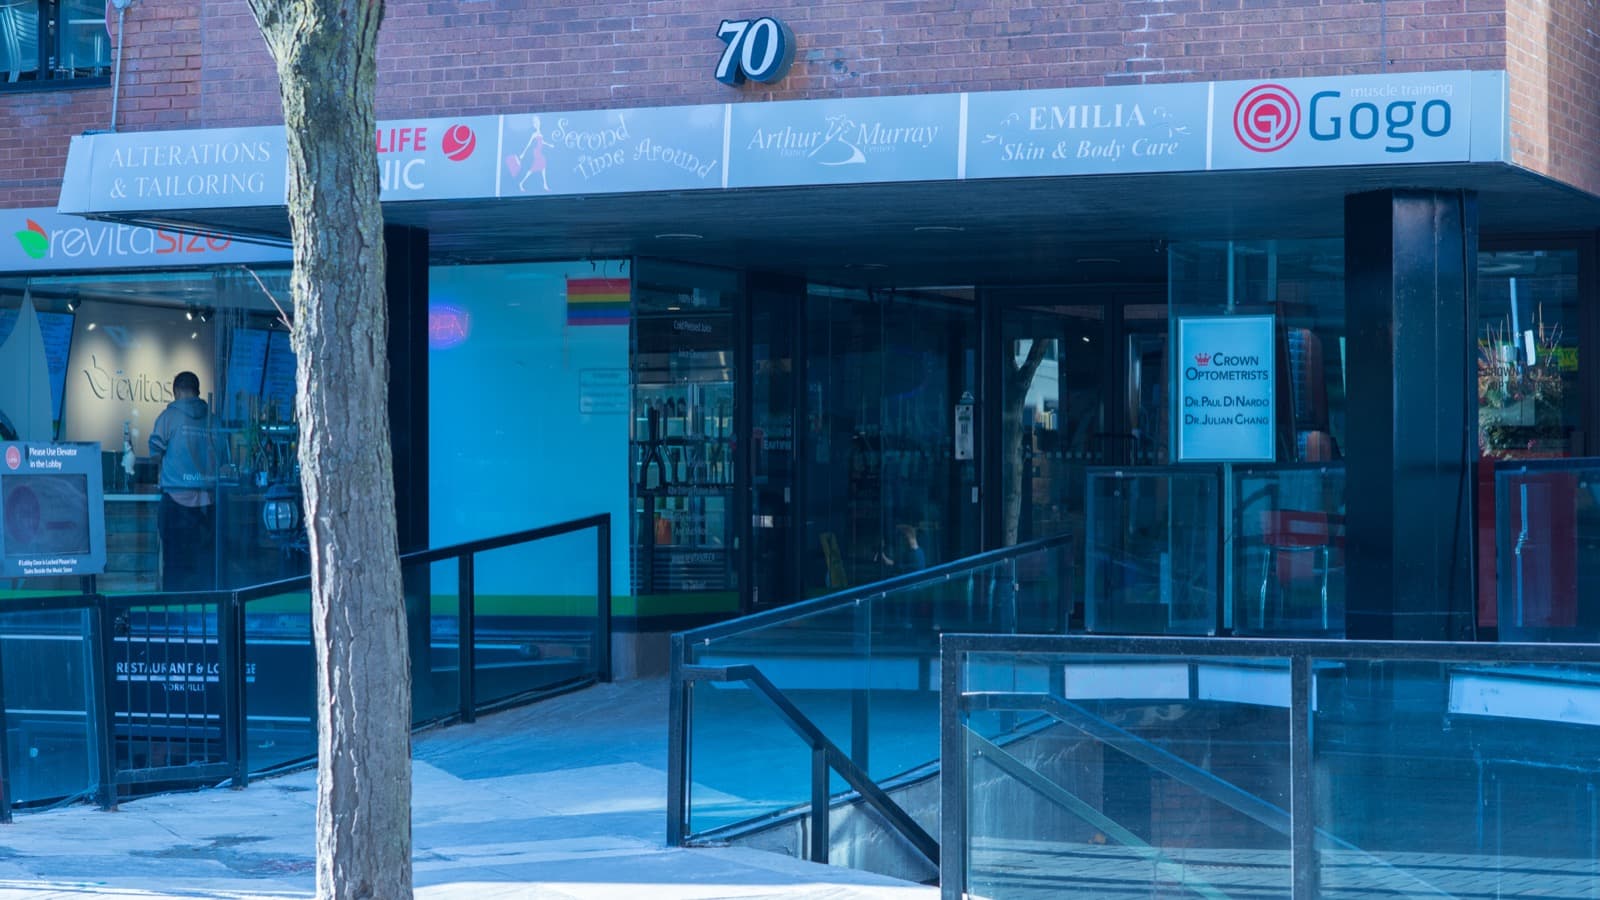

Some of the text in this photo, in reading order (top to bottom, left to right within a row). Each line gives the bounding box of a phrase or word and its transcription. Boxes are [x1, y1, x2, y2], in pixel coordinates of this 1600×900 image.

[715, 17, 785, 80] 70
[1350, 82, 1454, 98] muscle training
[1028, 103, 1147, 131] EMILIA
[1308, 90, 1452, 153] Gogo
[375, 127, 428, 153] LIFE
[551, 112, 632, 151] Second
[746, 122, 939, 150] Arthur Murray
[109, 141, 271, 169] ALTERATIONS
[573, 137, 718, 181] Time Around
[1001, 137, 1180, 162] Skin & Body Care
[110, 172, 265, 200] & TAILORING
[29, 447, 77, 457] Please Use Elevator
[29, 459, 62, 470] in the Lobby
[116, 661, 194, 674] RESTAURANT
[195, 662, 204, 674] &
